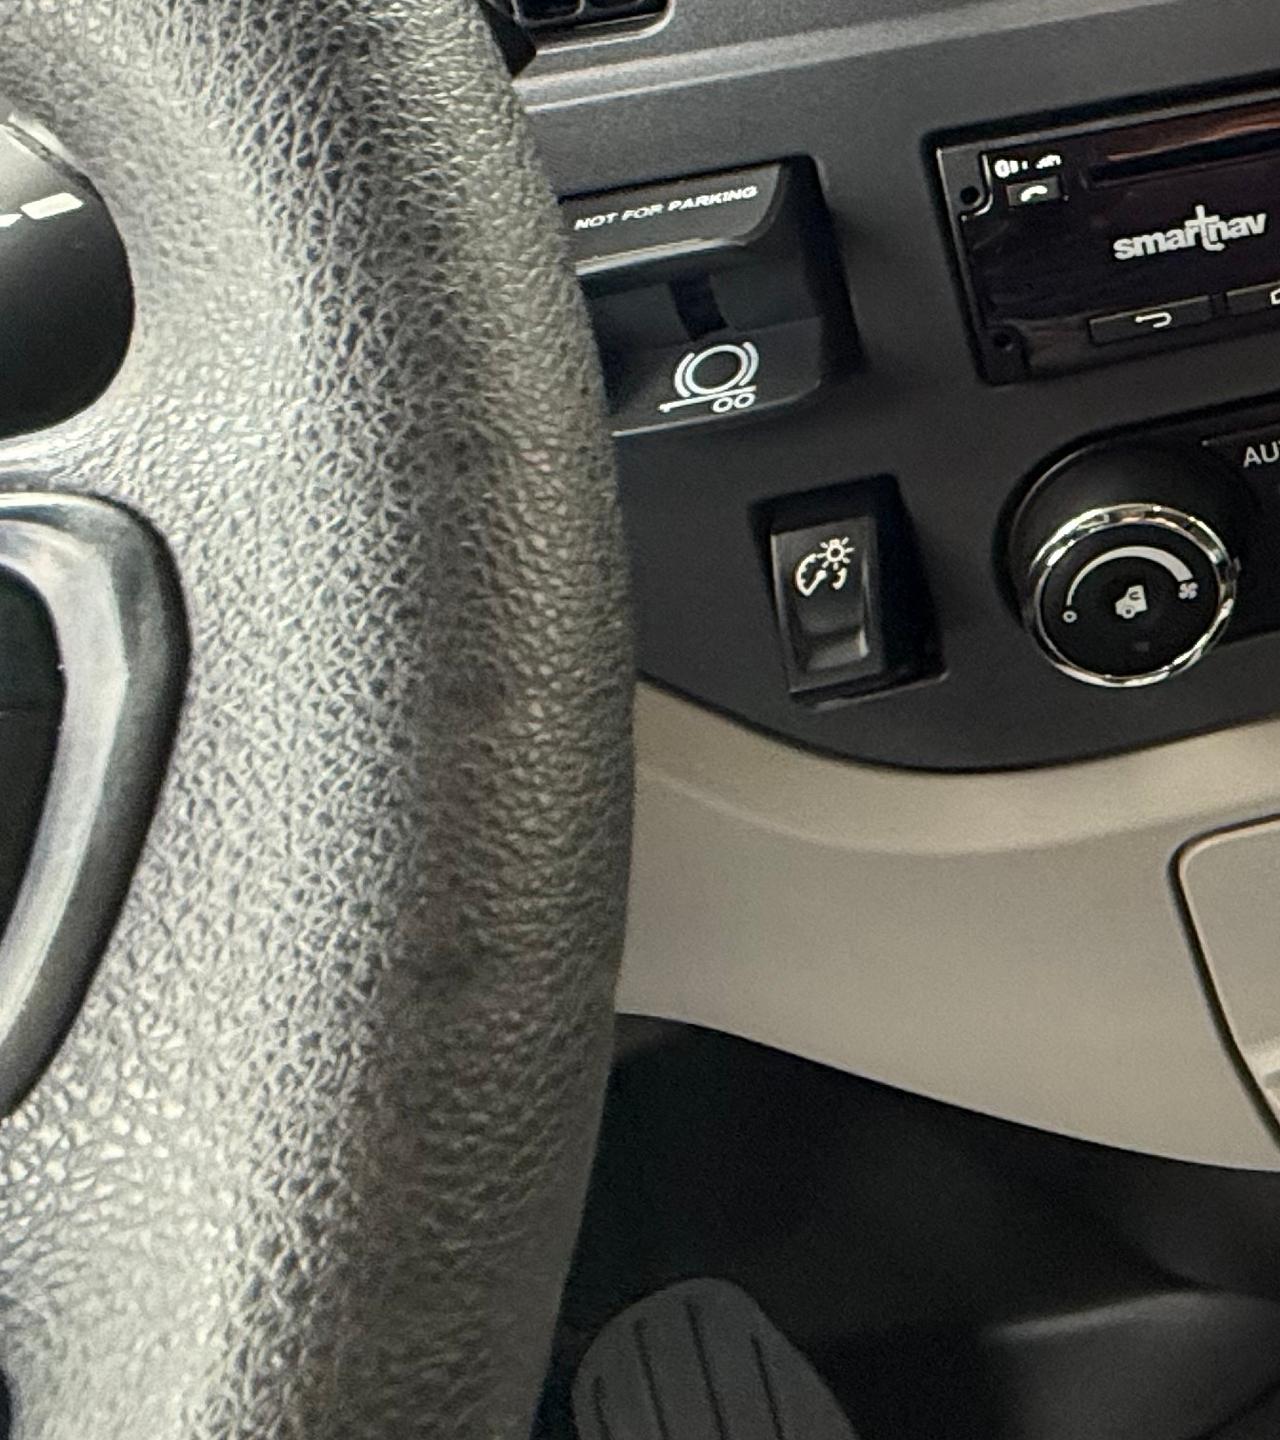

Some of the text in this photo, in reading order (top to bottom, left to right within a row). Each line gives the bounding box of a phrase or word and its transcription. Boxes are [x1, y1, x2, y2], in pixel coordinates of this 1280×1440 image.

[573, 185, 759, 231] NOT FOR PARKING
[1113, 204, 1267, 260] smartnav
